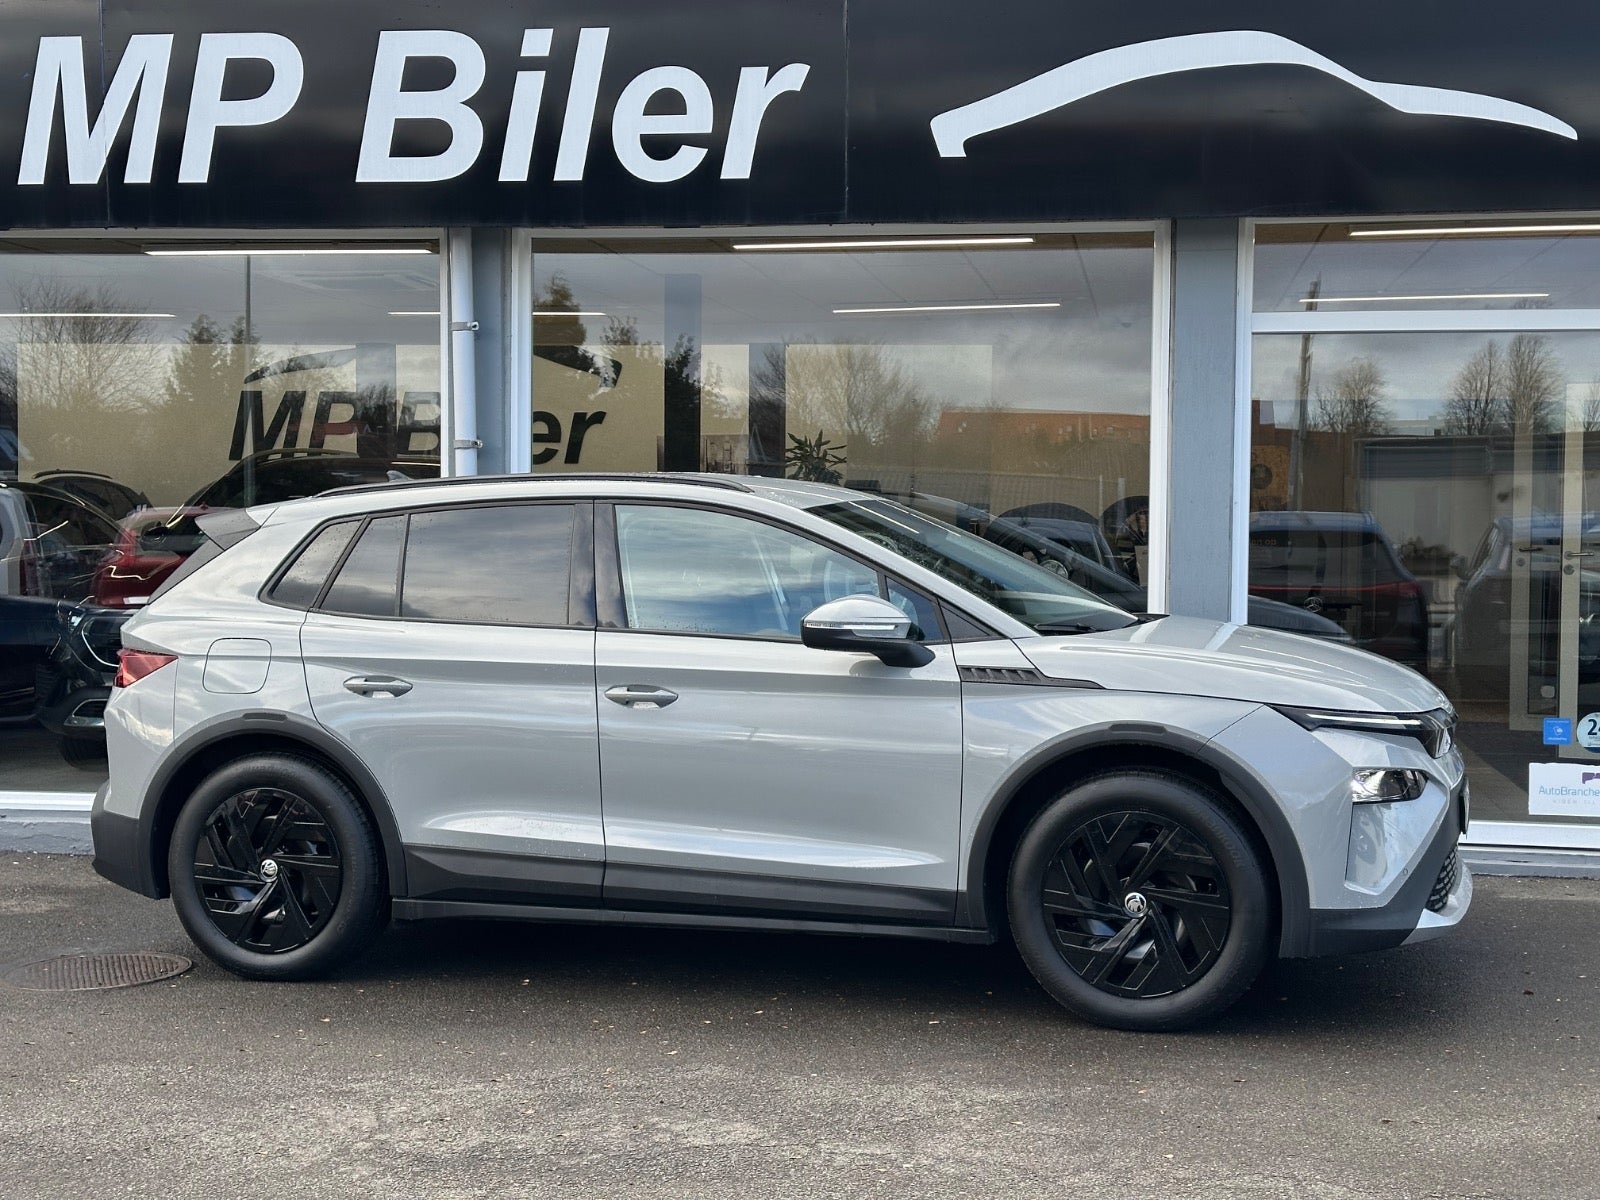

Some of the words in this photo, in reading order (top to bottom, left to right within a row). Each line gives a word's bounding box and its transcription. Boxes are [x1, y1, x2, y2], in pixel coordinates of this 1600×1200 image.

[17, 34, 304, 185] MP
[355, 27, 811, 183] Biler
[229, 390, 367, 459] MP
